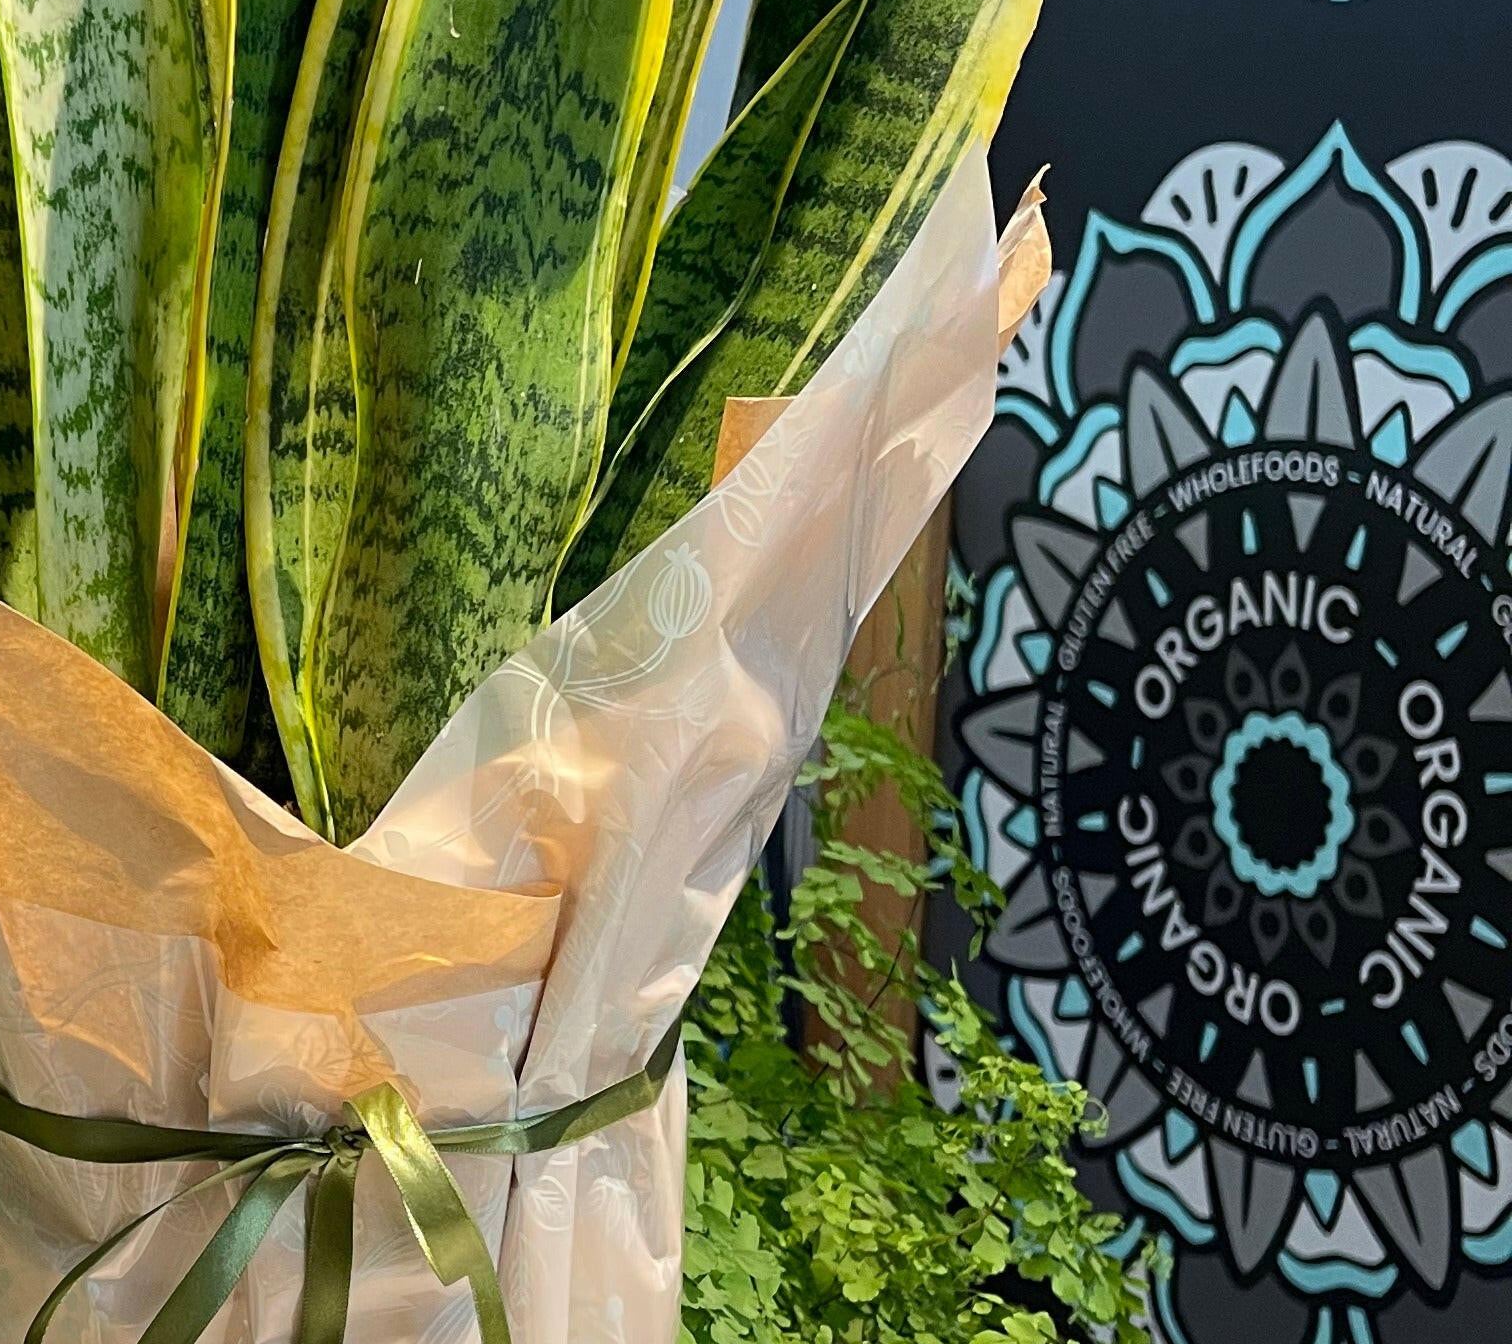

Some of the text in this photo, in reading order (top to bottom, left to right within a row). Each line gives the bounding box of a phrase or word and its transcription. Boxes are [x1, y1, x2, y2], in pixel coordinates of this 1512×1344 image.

[1058, 450, 1479, 671] GLUTEN FREE WHOLEFOODS NATURAL
[1134, 570, 1360, 719] ORGANIC
[1040, 701, 1152, 1063] WHOLEFOODS NATURAL
[1117, 794, 1301, 1036] ORGANIC
[1359, 679, 1468, 1009] ORGANIC
[1166, 1066, 1462, 1159] NATURAL GLUTEN FREE
